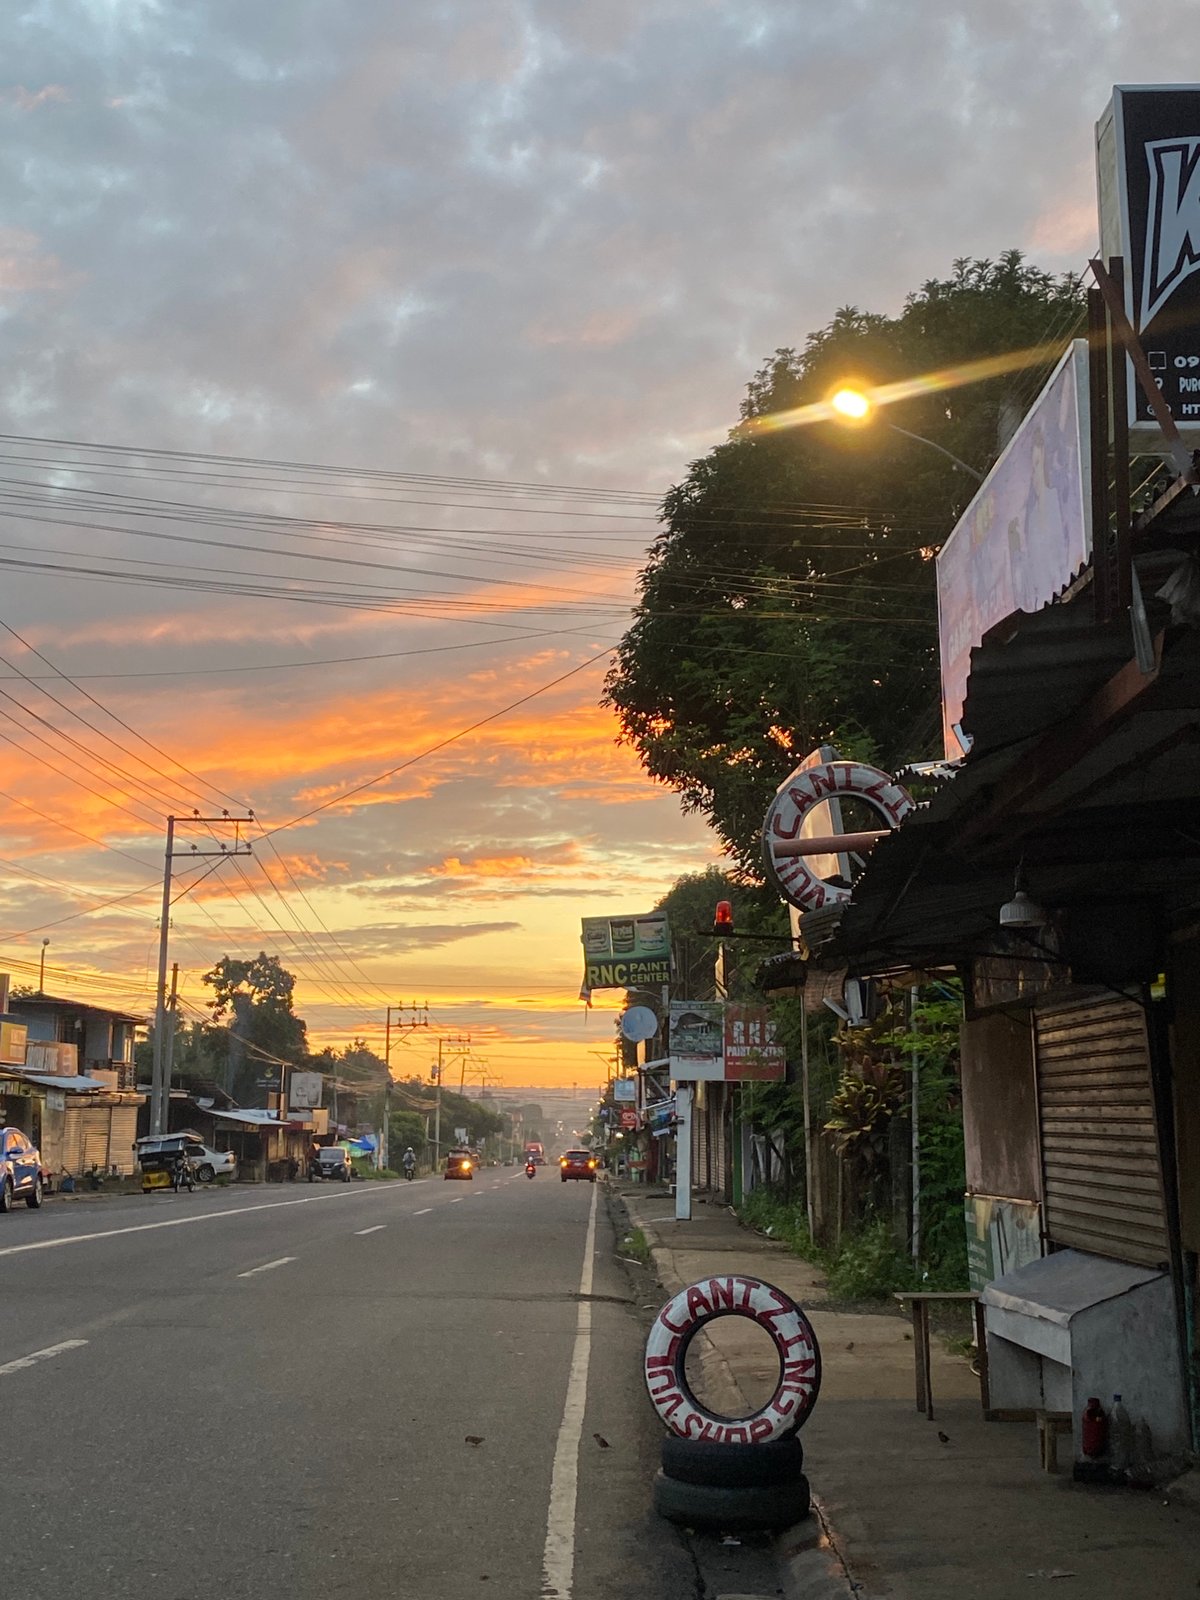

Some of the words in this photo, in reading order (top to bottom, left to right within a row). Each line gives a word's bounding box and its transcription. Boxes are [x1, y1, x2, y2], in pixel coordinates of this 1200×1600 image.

[587, 963, 628, 987] RNC
[630, 961, 669, 973] PAINT
[631, 971, 670, 983] CENTER
